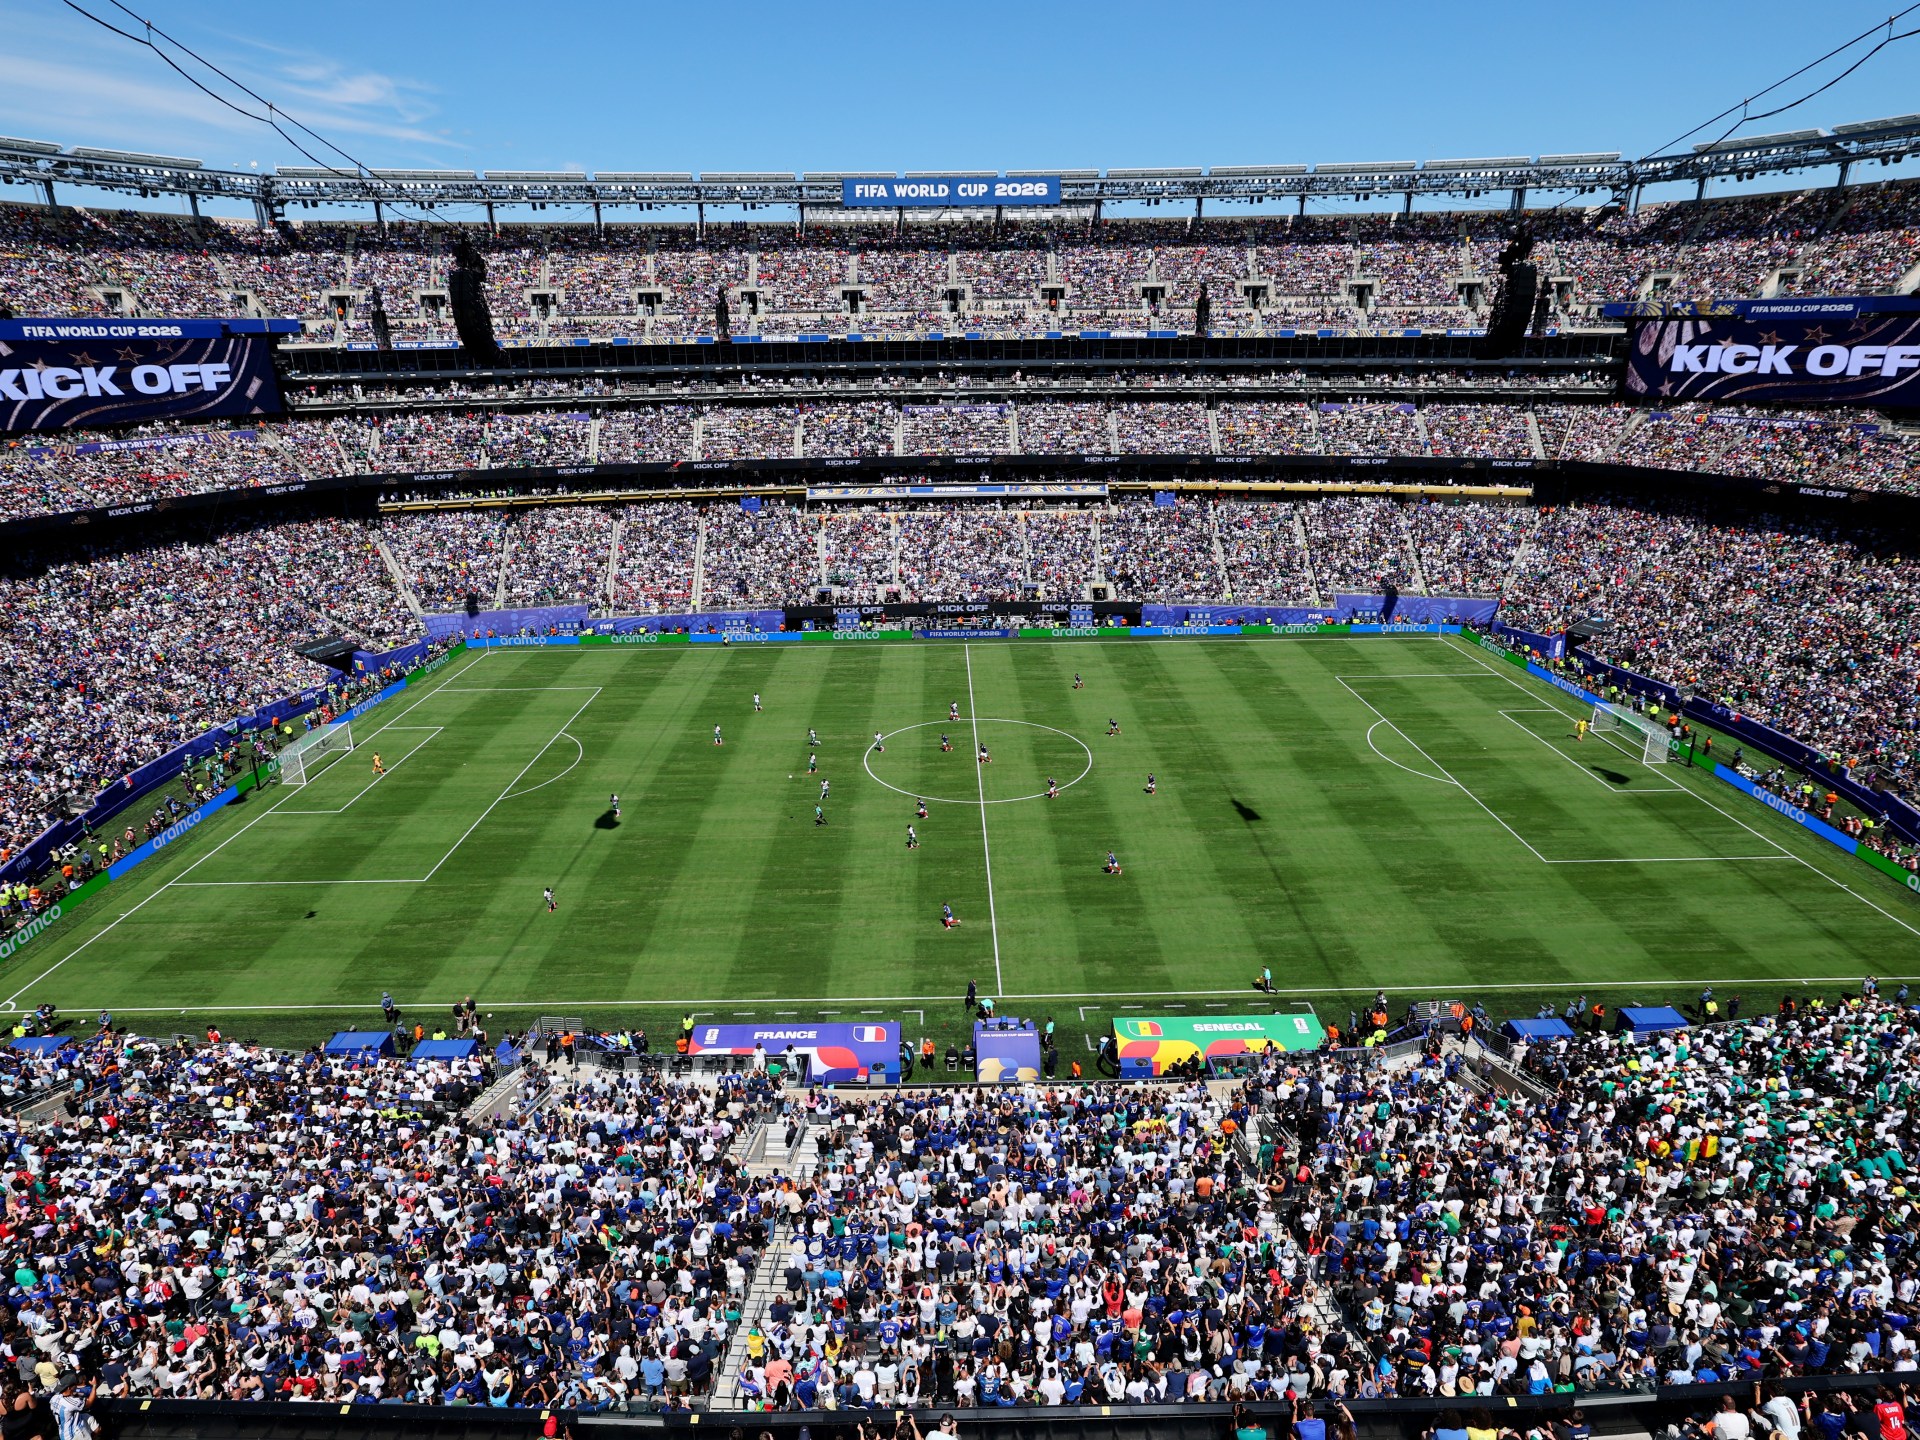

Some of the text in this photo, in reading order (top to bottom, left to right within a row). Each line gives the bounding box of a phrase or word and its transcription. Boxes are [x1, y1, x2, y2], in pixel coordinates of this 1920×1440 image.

[855, 182, 1048, 198] FIFA WORLD CUP 2026
[1770, 305, 1801, 313] WORLD
[1821, 304, 1854, 312] 2026
[22, 326, 183, 337] FIFA WORLD CUP 2026
[1671, 344, 1920, 377] KICK OFF
[0, 363, 231, 400] KICK OFF
[100, 442, 120, 451] FIFA
[266, 483, 306, 495] KICK OFF
[1799, 486, 1848, 498] KICK OFF
[108, 504, 152, 517] KICK OFF
[833, 606, 884, 615] KICK OFF
[937, 604, 988, 613] KICK OFF
[1042, 604, 1093, 612] KICK OFF
[1051, 627, 1099, 637] aramco
[1162, 625, 1209, 635] aramco
[1272, 624, 1318, 634] aramco
[1381, 623, 1428, 633] aramco
[500, 634, 547, 646] aramco
[611, 634, 658, 644] aramco
[833, 630, 880, 640] aramco
[1480, 637, 1506, 658] aramco
[425, 653, 450, 674] aramco
[1551, 675, 1585, 699] aramco
[301, 692, 316, 702] FIFA
[352, 693, 383, 717] aramco
[1752, 785, 1806, 824] aramco
[153, 811, 201, 850] aramco
[16, 856, 32, 872] FIFA
[0, 904, 62, 959] aramco
[1193, 1023, 1265, 1032] SENEGAL
[753, 1031, 818, 1040] FRANCE
[885, 1330, 894, 1338] 10
[1890, 1416, 1900, 1429] 14
